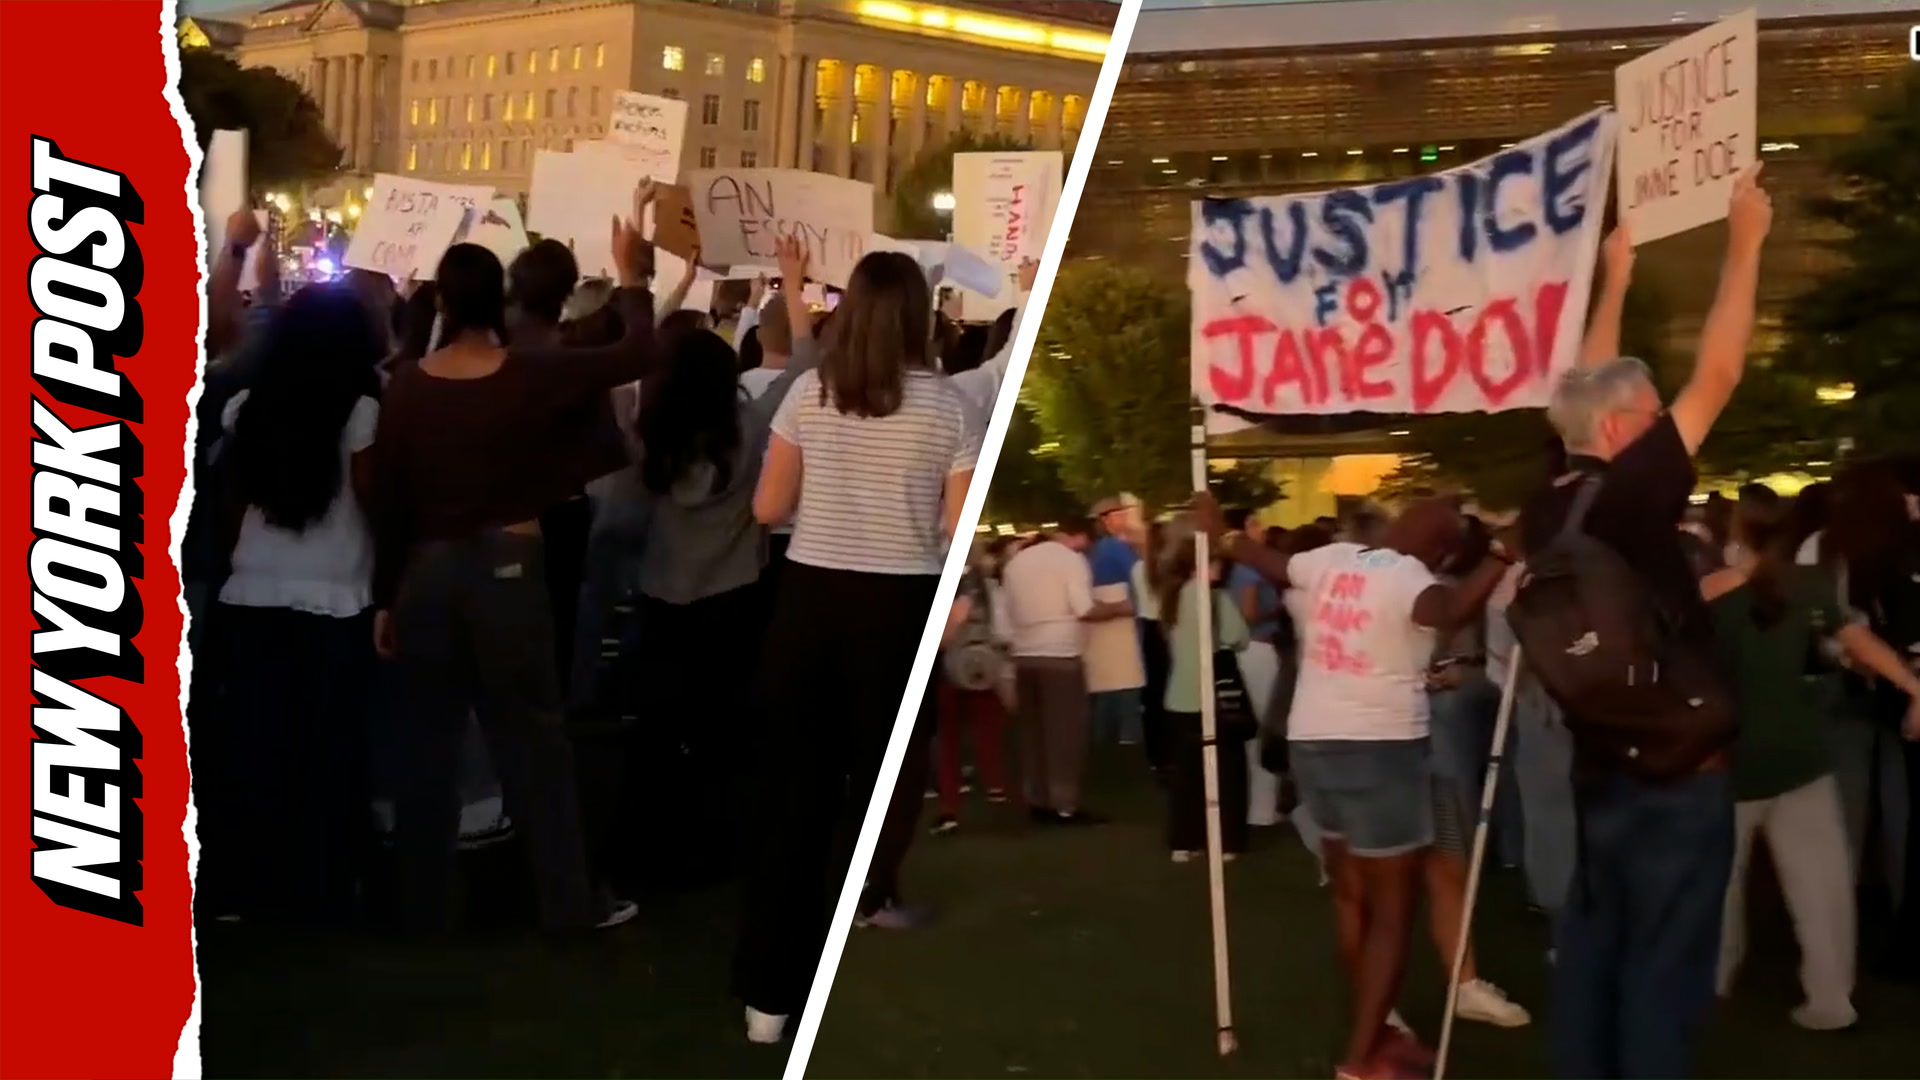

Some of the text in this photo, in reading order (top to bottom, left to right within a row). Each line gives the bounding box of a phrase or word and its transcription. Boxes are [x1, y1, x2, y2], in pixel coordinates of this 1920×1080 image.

[1629, 35, 1739, 133] JUSTICE
[1661, 111, 1703, 153] FOR
[1694, 132, 1740, 187] DOE
[708, 175, 776, 218] AN
[1200, 116, 1602, 285] JUSTICE
